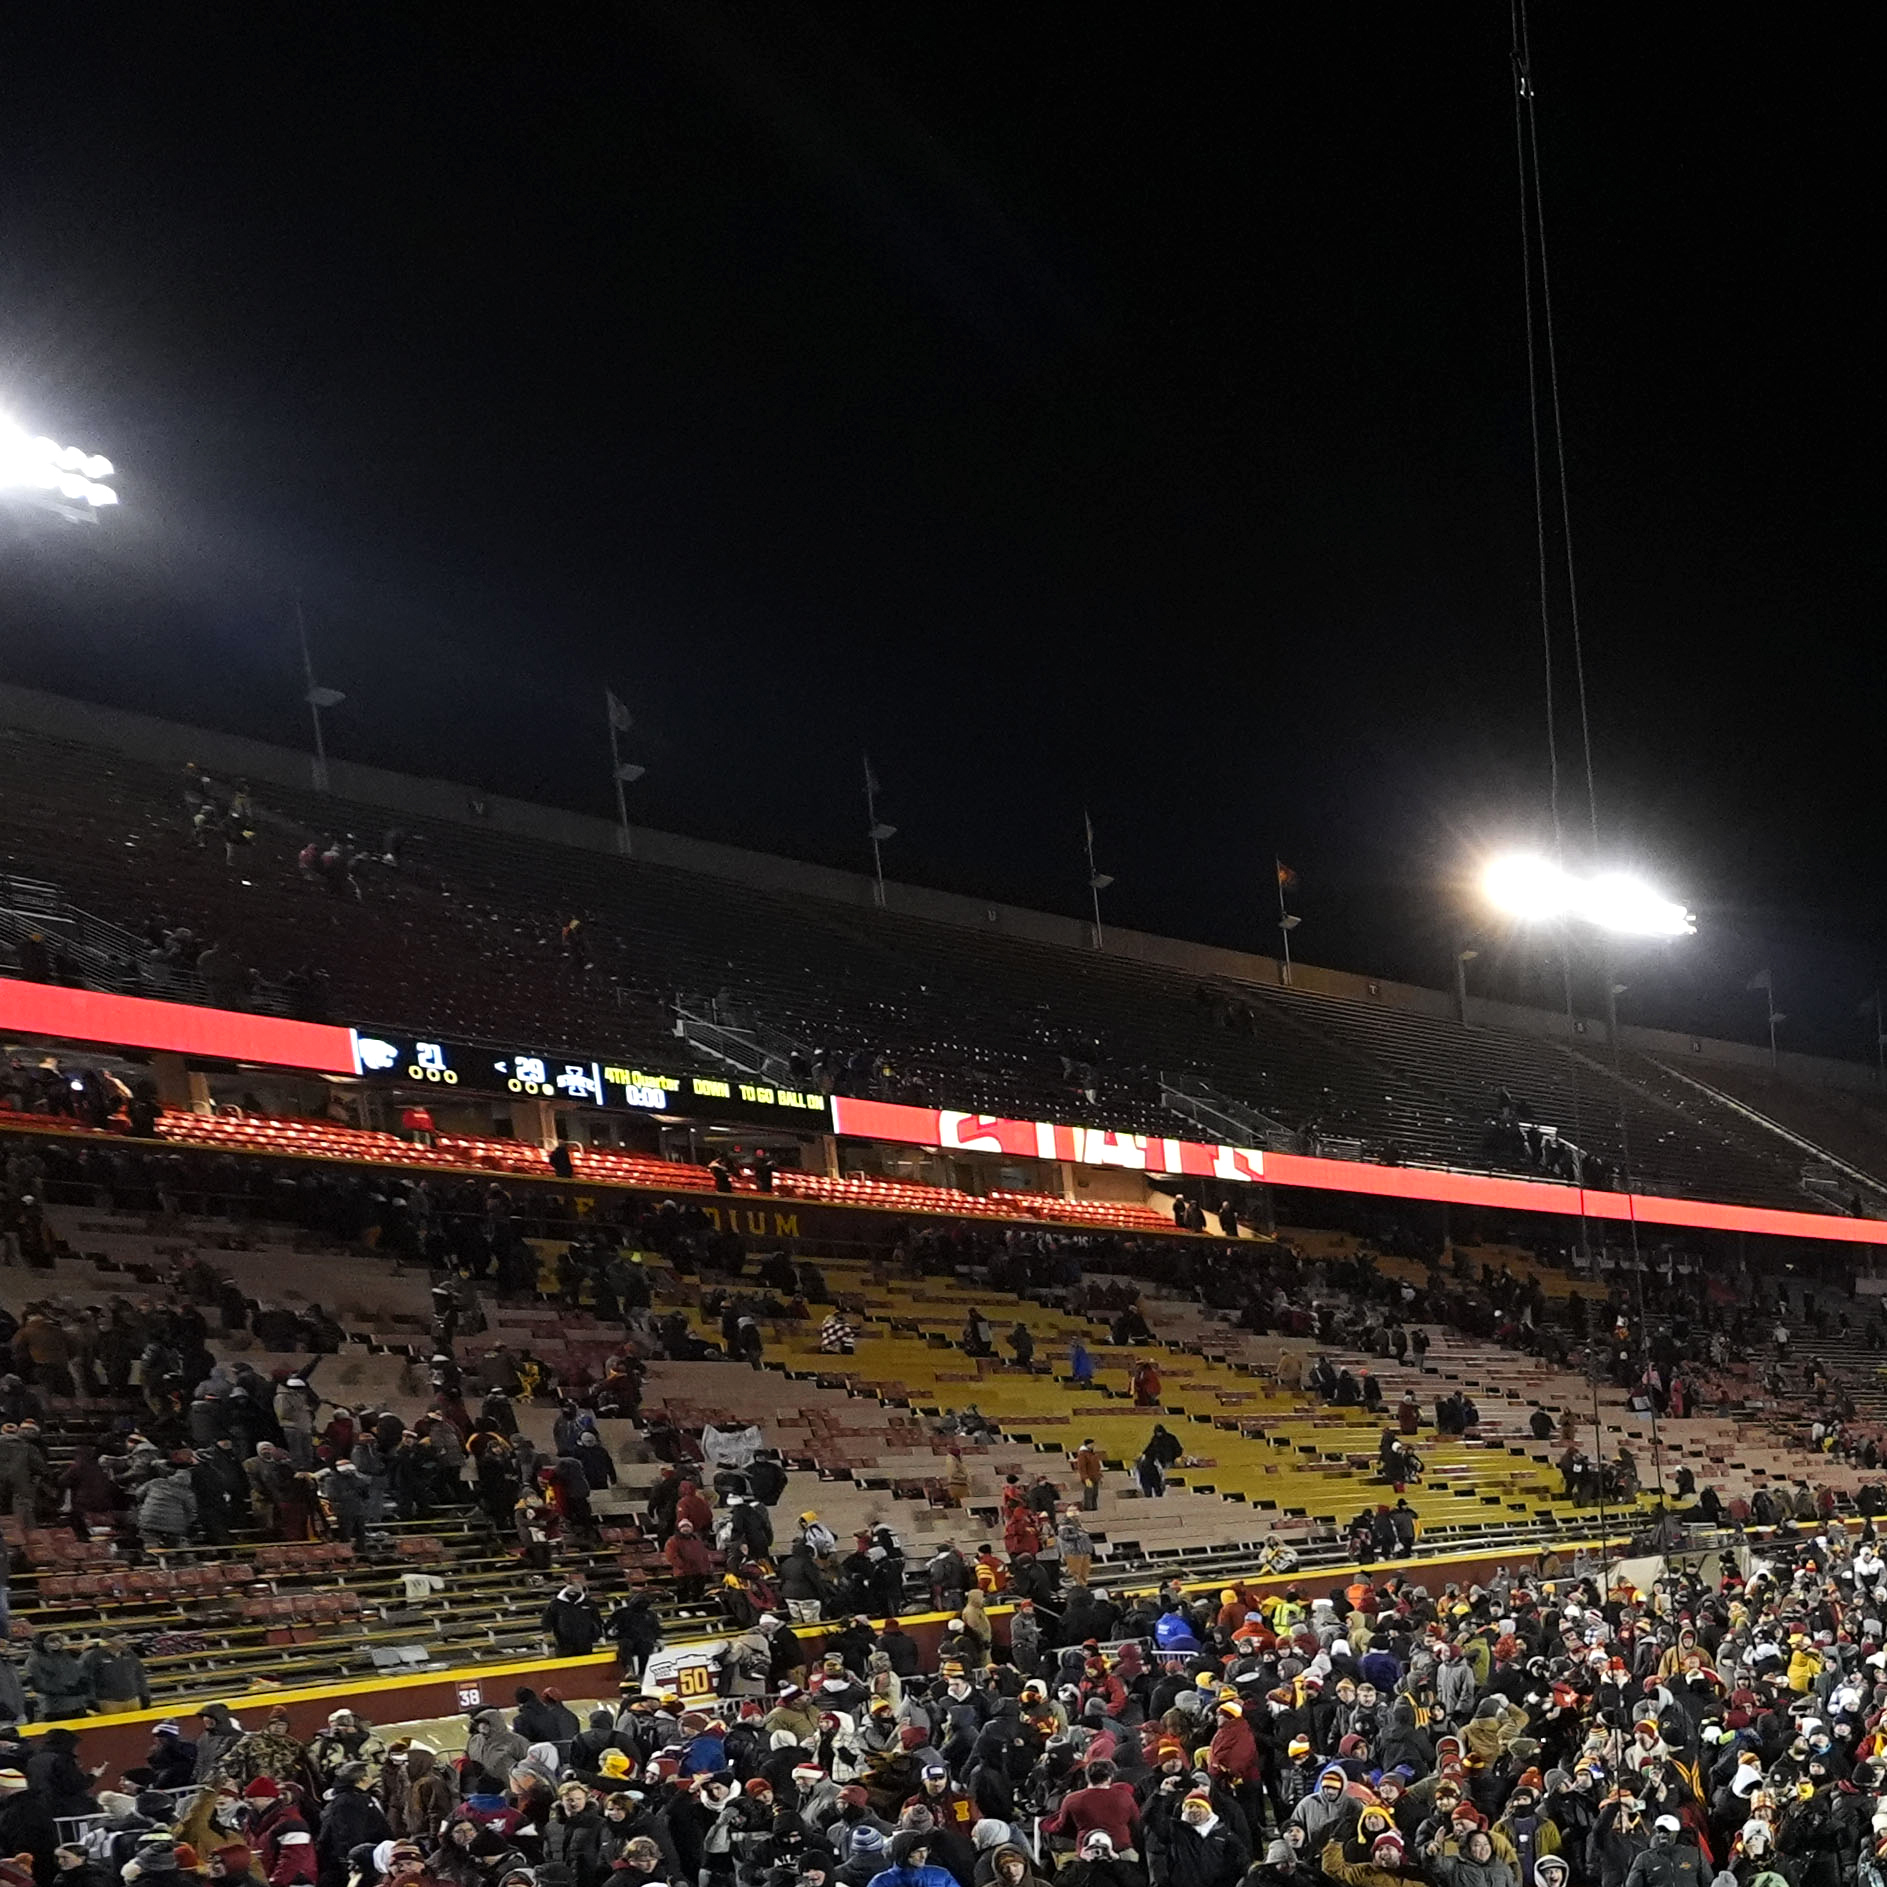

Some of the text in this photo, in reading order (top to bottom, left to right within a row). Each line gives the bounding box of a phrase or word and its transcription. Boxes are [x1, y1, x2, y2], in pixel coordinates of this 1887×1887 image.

[416, 1042, 447, 1070] 21
[515, 1056, 545, 1083] 29
[605, 1067, 631, 1085] 4TH
[626, 1086, 666, 1109] 0:00
[693, 1078, 730, 1098] DOWN
[778, 1089, 806, 1109] BALL
[679, 1666, 709, 1696] 50
[459, 1688, 480, 1706] 38
